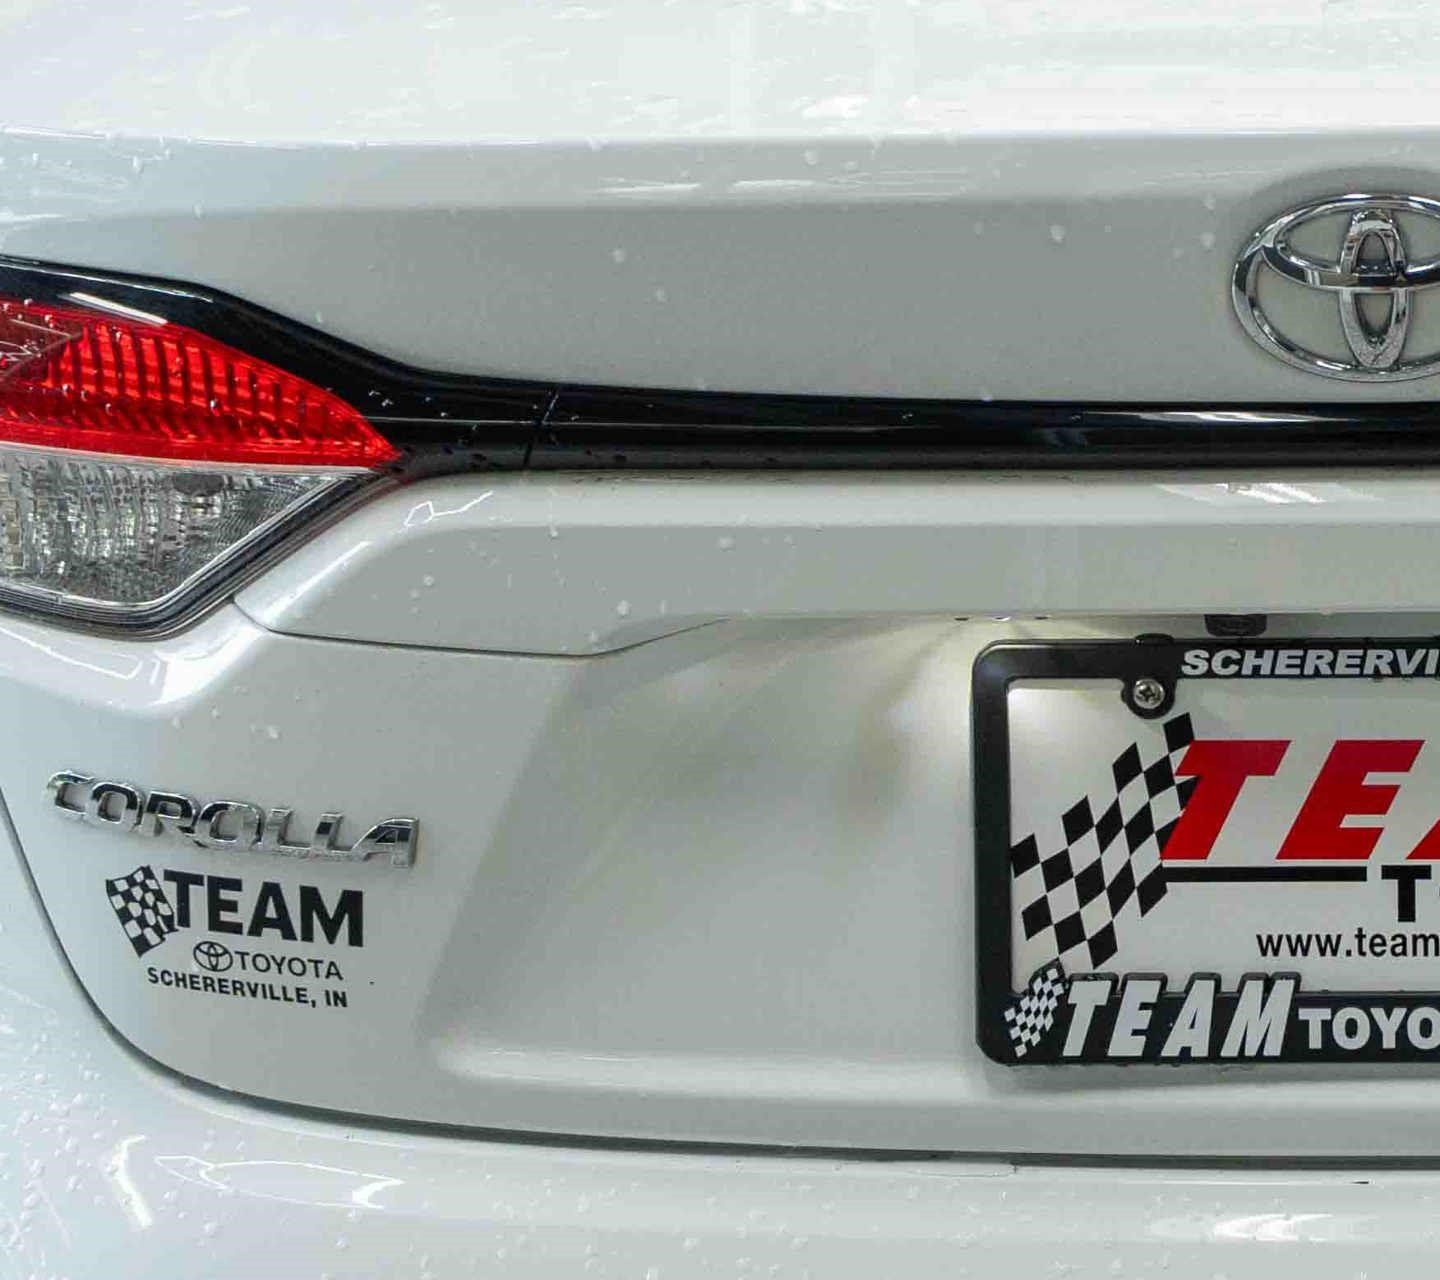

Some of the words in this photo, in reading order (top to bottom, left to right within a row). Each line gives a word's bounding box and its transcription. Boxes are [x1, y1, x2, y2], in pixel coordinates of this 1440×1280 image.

[47, 771, 420, 867] COROLLA
[163, 869, 364, 947] TEAM
[146, 966, 317, 1008] SCHERERVILLE,
[325, 989, 348, 1008] IN
[234, 950, 344, 981] TOYOTA
[1063, 979, 1295, 1056] TEAM
